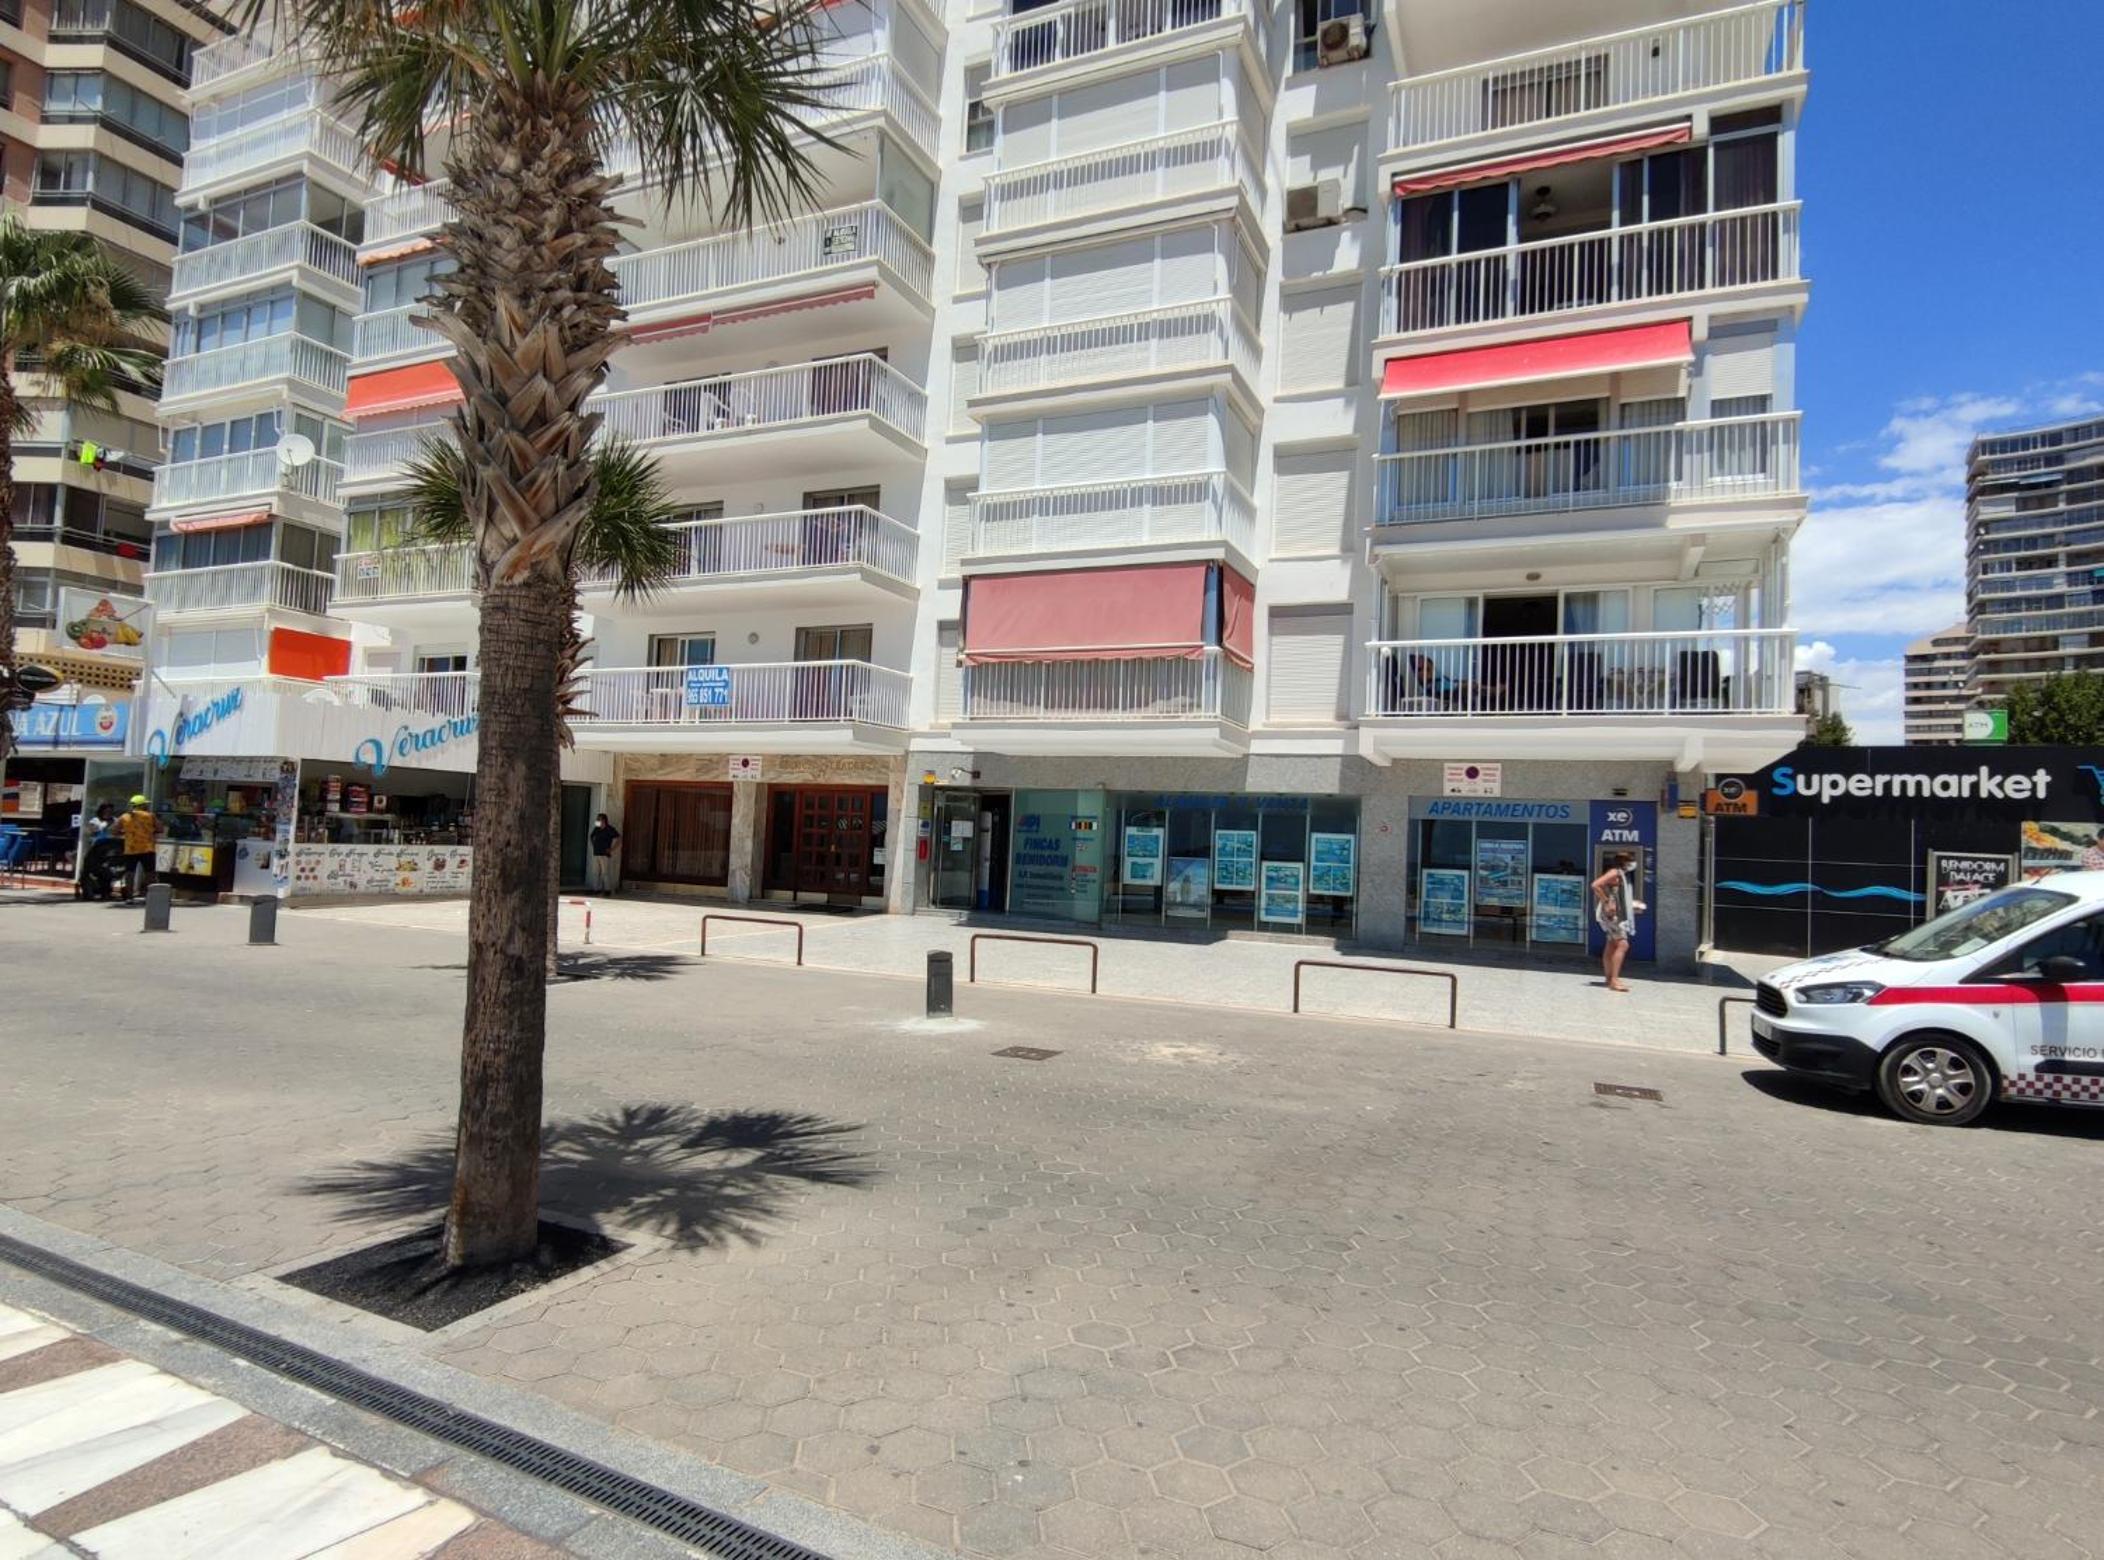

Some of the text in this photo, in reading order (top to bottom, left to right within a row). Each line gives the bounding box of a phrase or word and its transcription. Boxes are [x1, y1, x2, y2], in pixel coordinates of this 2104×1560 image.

[687, 668, 729, 681] ALQUILA
[33, 710, 83, 736] AZUL
[147, 687, 242, 768] Veracruz
[1771, 766, 2052, 804] Supermarket
[1428, 800, 1571, 819] APARTAMENTOS
[1714, 802, 1748, 814] ATM
[1601, 828, 1640, 843] ATM
[1023, 837, 1062, 852] FINCAS
[1940, 859, 2006, 875] BENIDORM
[1949, 870, 1997, 884] PALACE
[2030, 1044, 2097, 1059] SERVICIO
